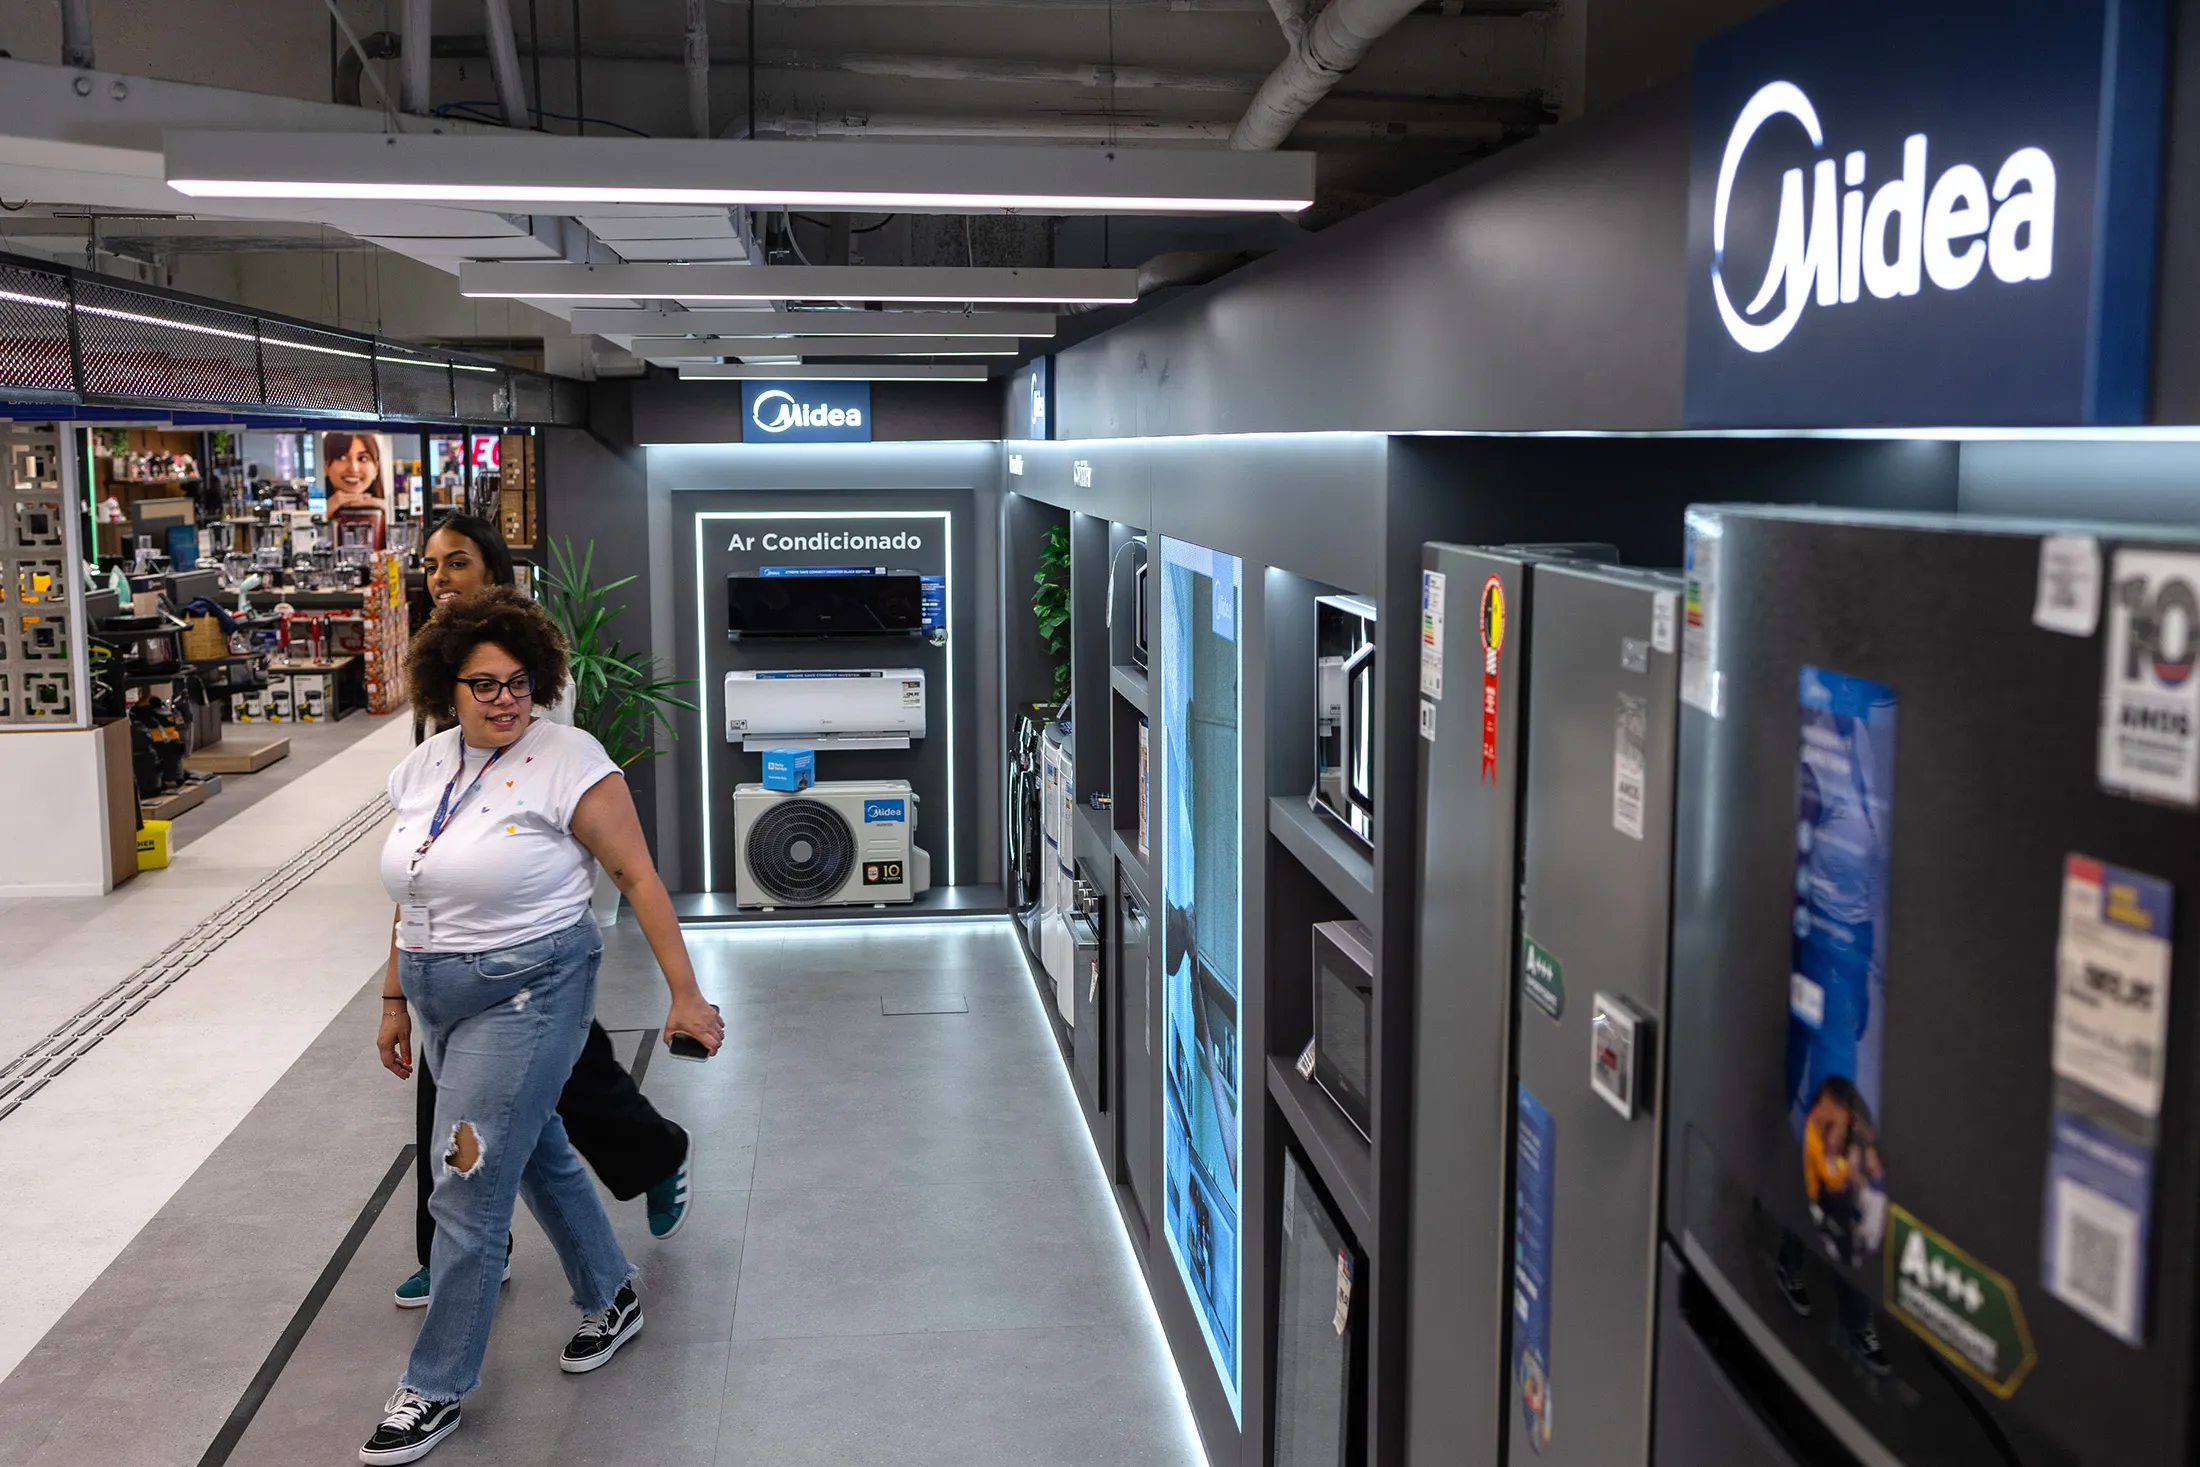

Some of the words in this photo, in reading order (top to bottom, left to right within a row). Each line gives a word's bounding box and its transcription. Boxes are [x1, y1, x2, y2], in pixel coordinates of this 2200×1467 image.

[1711, 80, 2056, 352] Midea
[753, 390, 862, 433] Midea
[728, 534, 755, 551] Ar
[762, 532, 922, 551] Condicionado
[868, 805, 902, 818] Midea
[883, 865, 900, 877] 10
